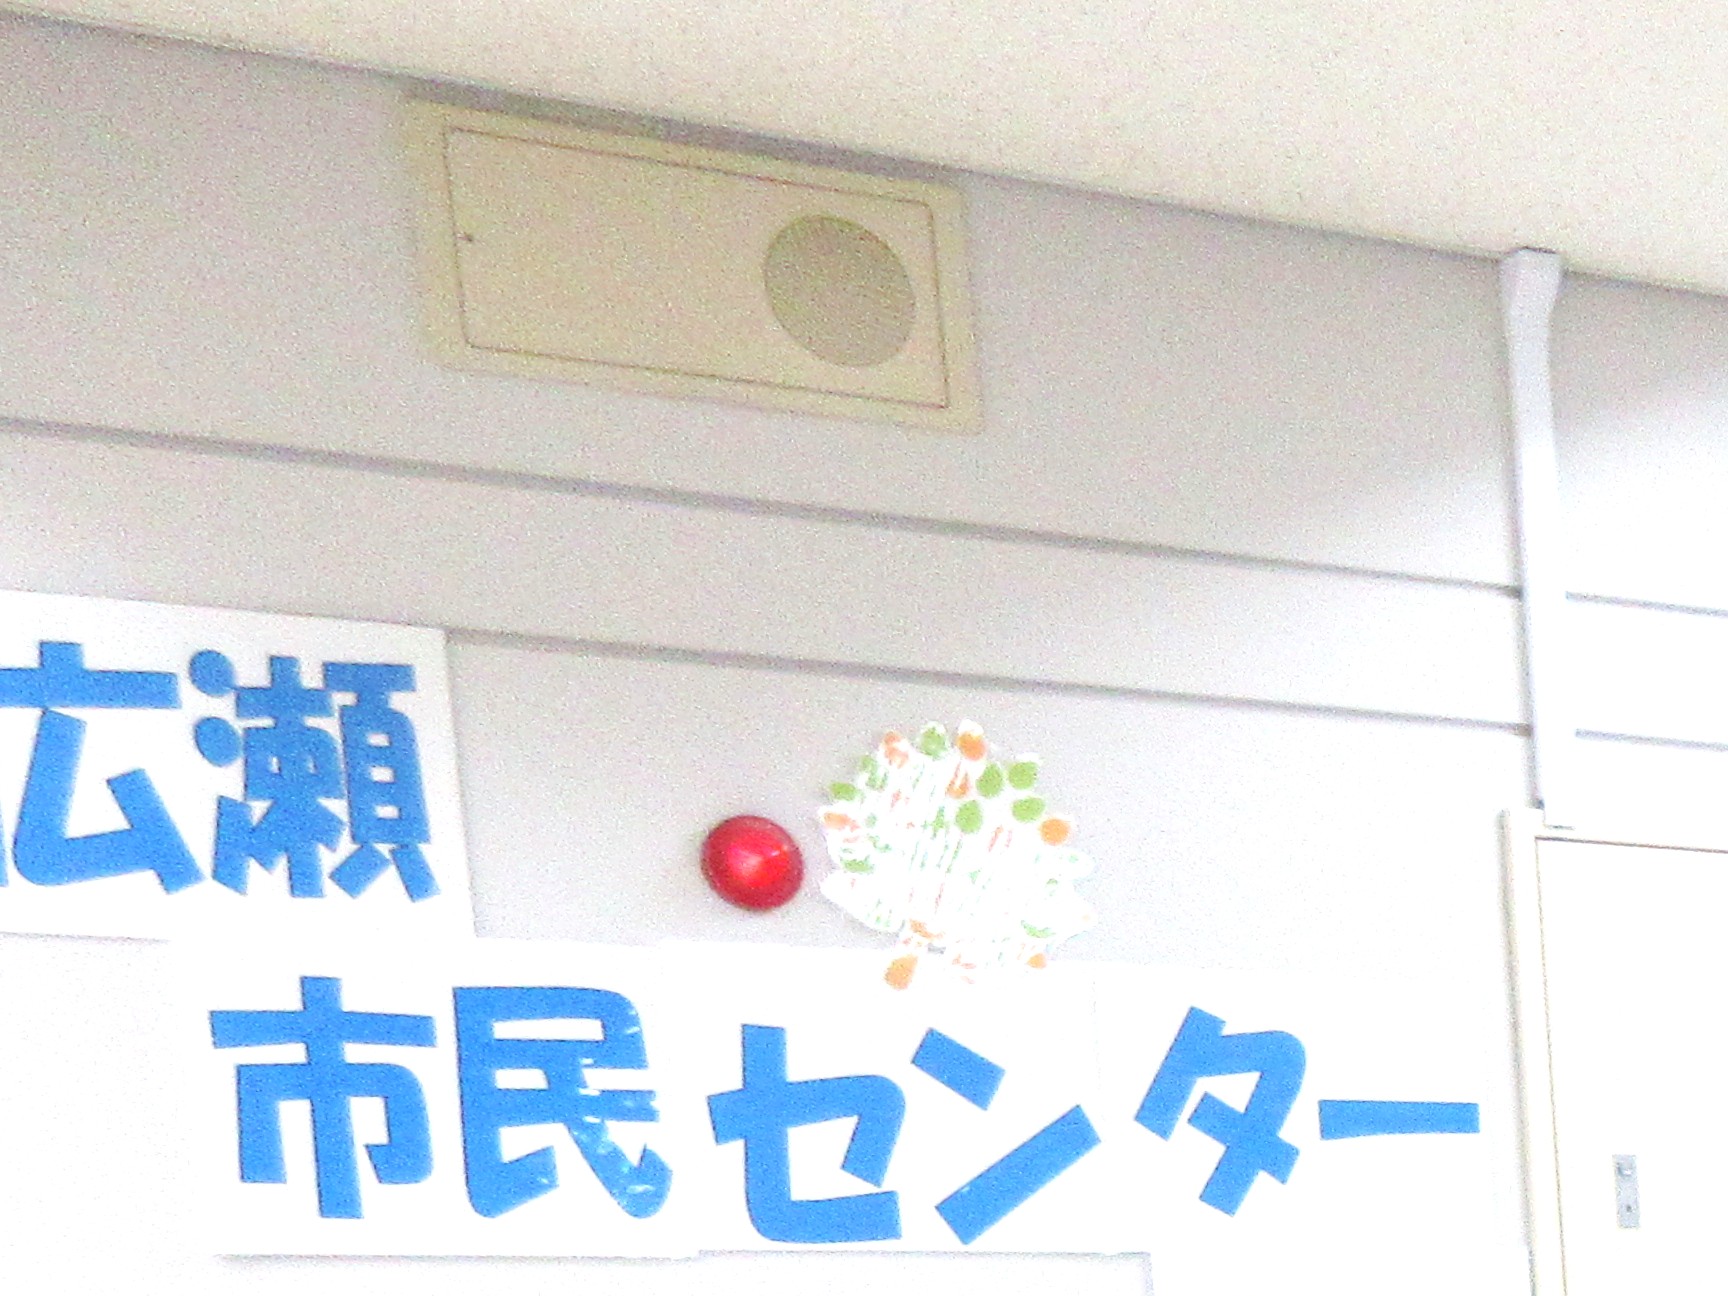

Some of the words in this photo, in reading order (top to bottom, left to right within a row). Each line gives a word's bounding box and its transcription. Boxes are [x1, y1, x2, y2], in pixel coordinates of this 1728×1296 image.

[0, 643, 438, 900] 広瀬
[208, 975, 1480, 1243] 市民センター
